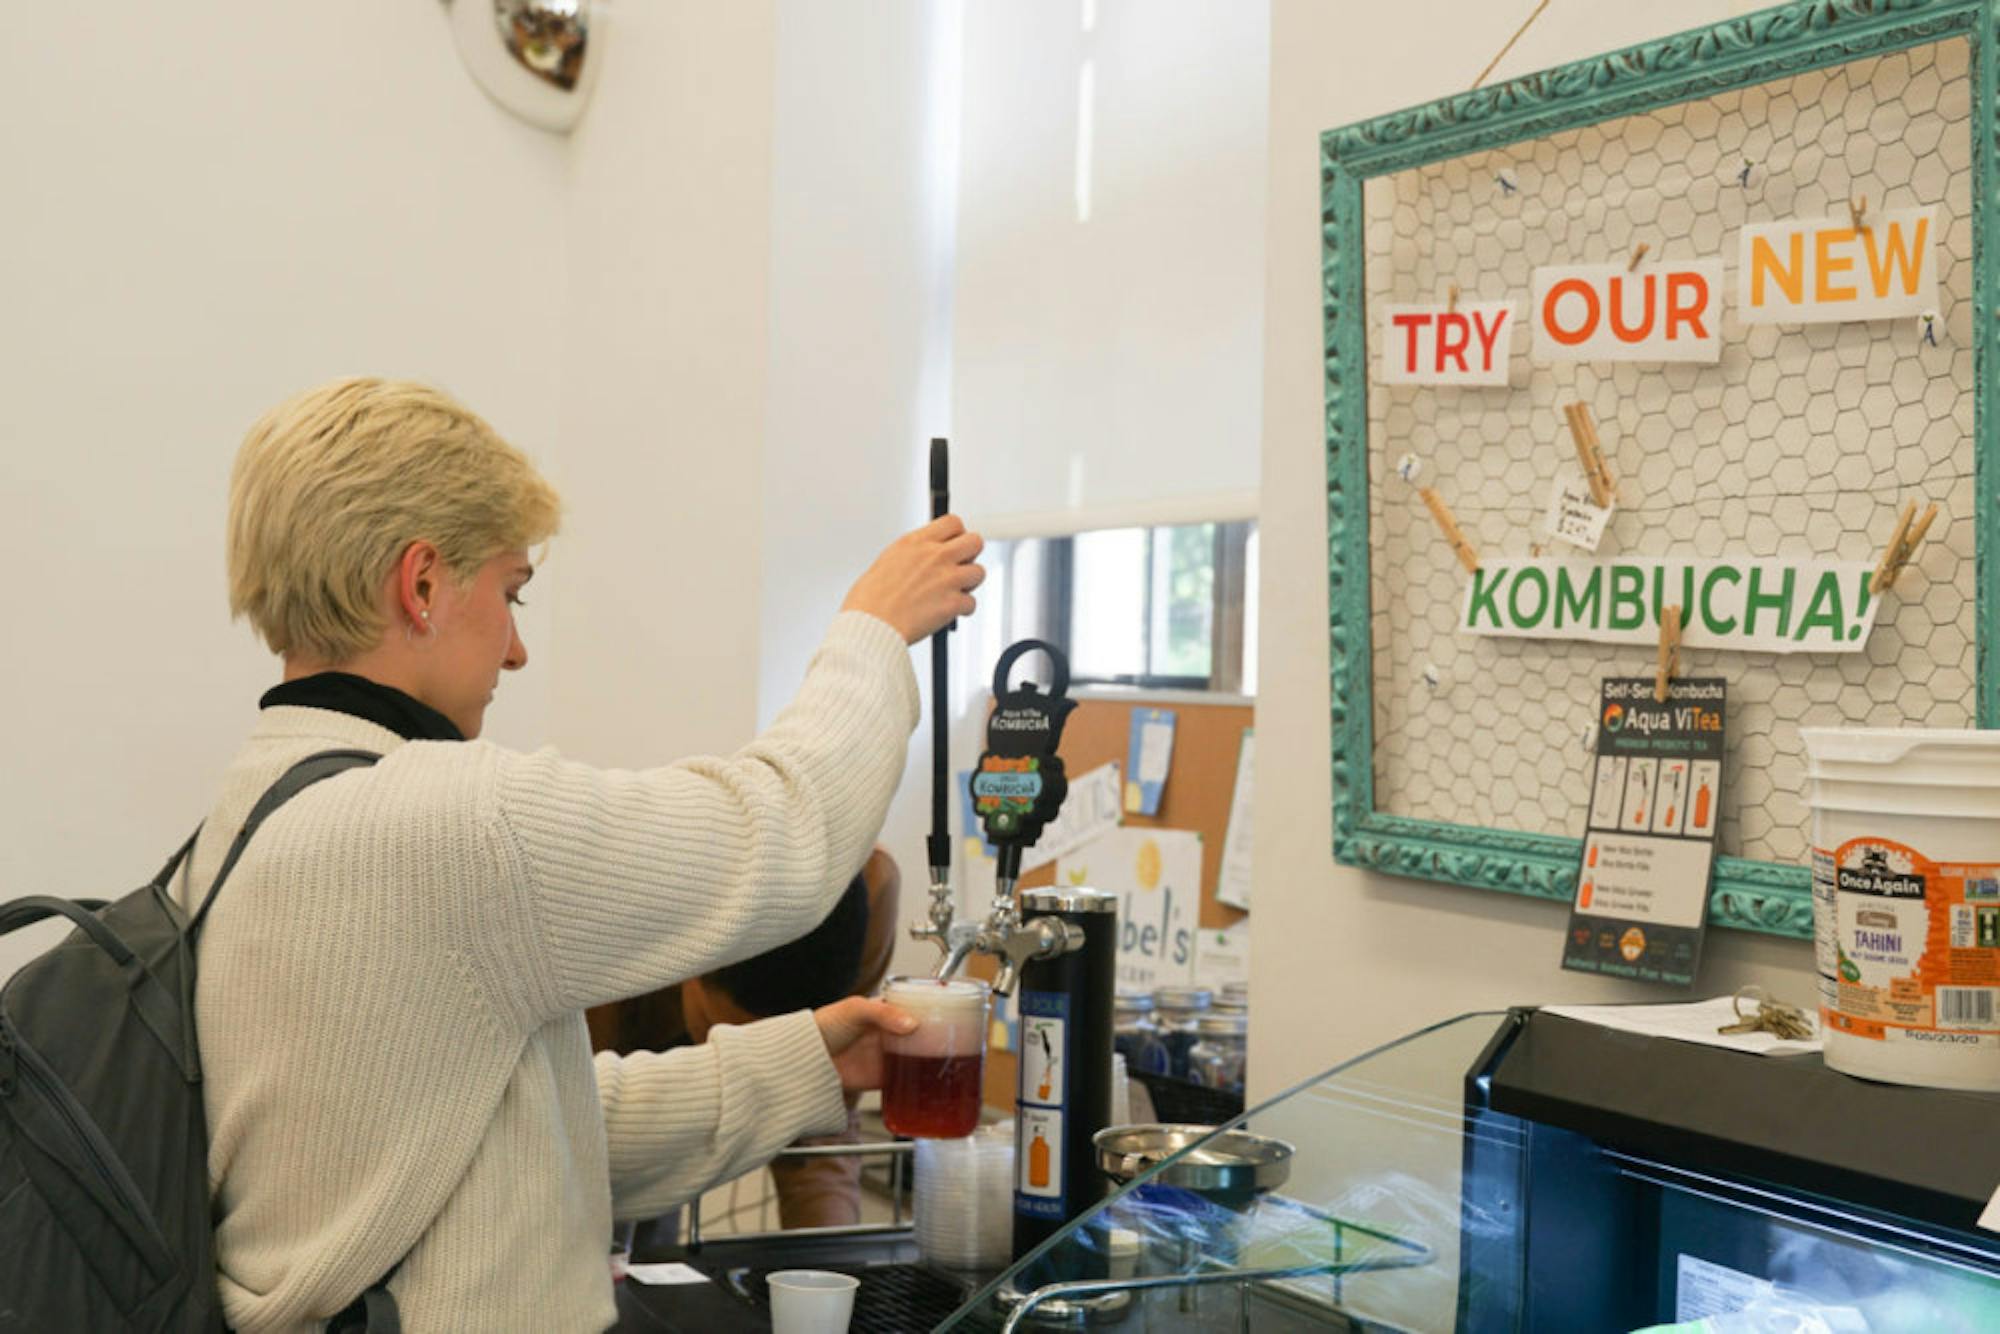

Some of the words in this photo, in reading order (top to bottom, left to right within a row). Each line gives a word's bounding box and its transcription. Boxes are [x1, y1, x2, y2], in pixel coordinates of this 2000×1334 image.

[1393, 309, 1509, 374] TRY
[1541, 270, 1710, 347] OUR
[1751, 217, 1930, 308] NEW
[1466, 564, 1875, 643] KOMBUCHA!
[1604, 682, 1659, 699] Self-Ser
[1624, 706, 1671, 735] Aqua
[1674, 706, 1721, 731] ViTea
[1840, 872, 1872, 890] Once
[1872, 876, 1921, 896] Again
[1119, 886, 1190, 965] bel's
[1855, 929, 1903, 953] TAHINI
